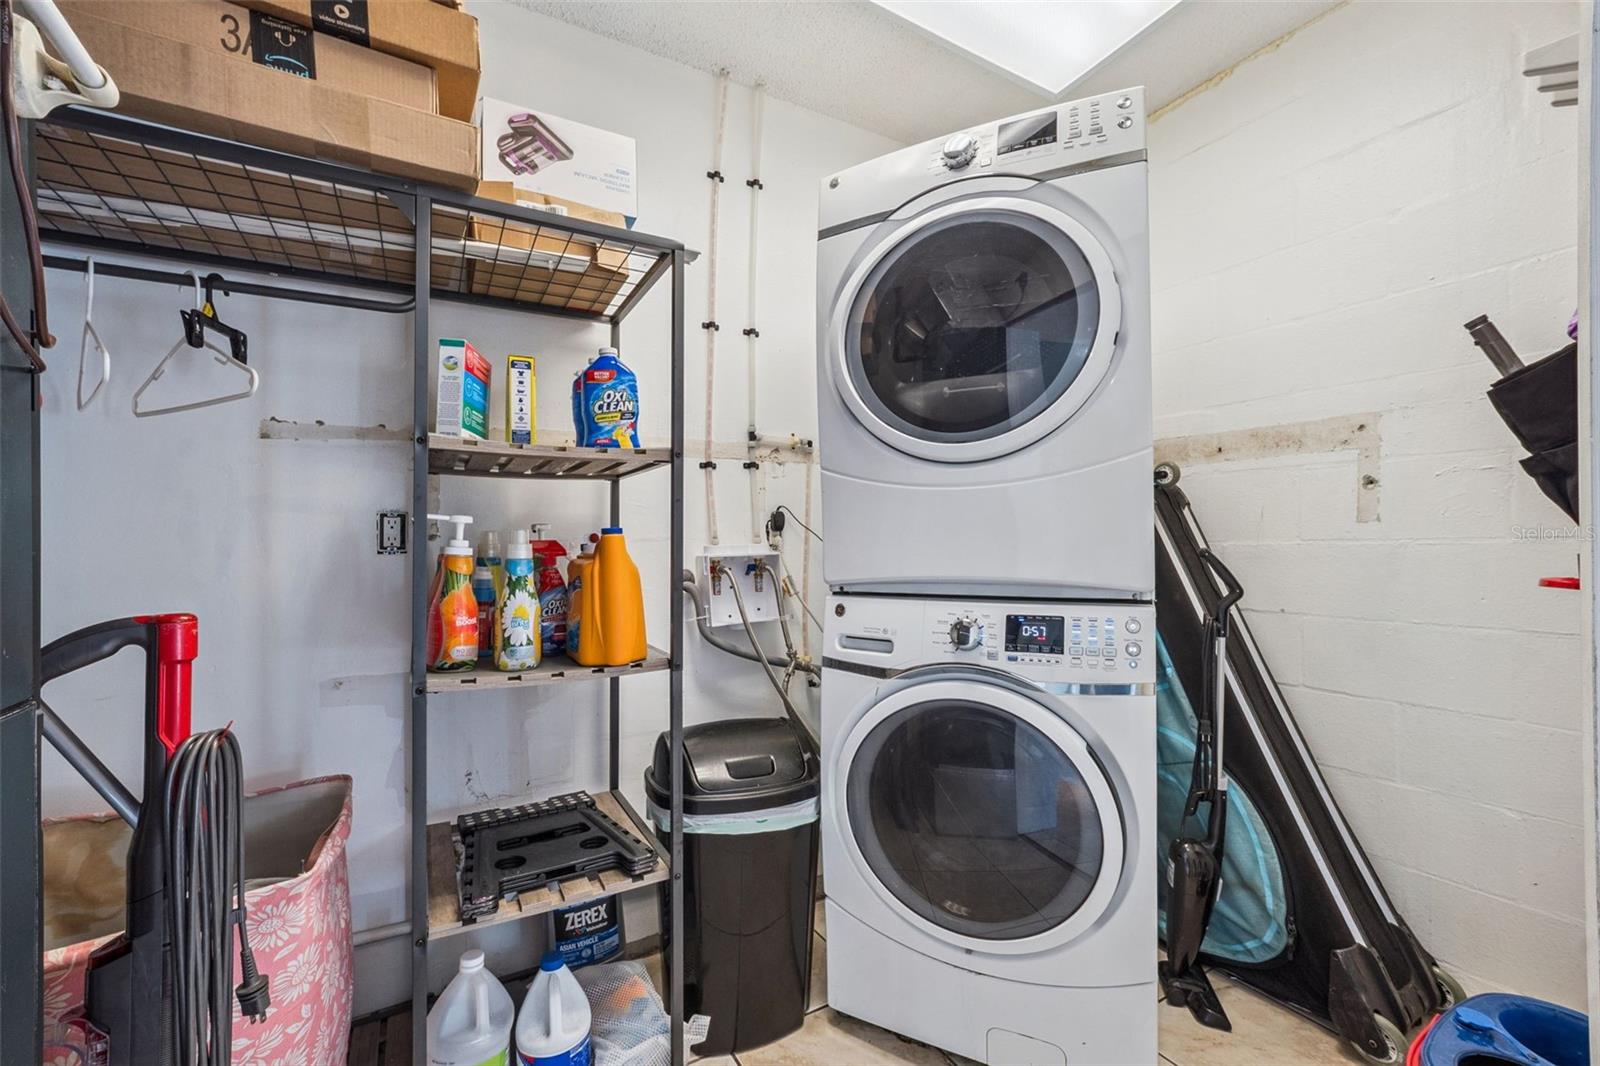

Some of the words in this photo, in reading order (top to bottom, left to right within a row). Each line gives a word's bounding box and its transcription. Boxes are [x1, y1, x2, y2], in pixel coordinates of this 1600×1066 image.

[318, 14, 336, 24] video
[336, 18, 366, 33] streaming
[603, 390, 627, 402] OXI
[594, 401, 633, 413] CLEAN
[548, 600, 564, 609] OXI
[1022, 625, 1047, 637] 0:57
[564, 904, 608, 931] ZEREX
[559, 943, 577, 952] ASIAN
[577, 936, 599, 949] VEHICLE
